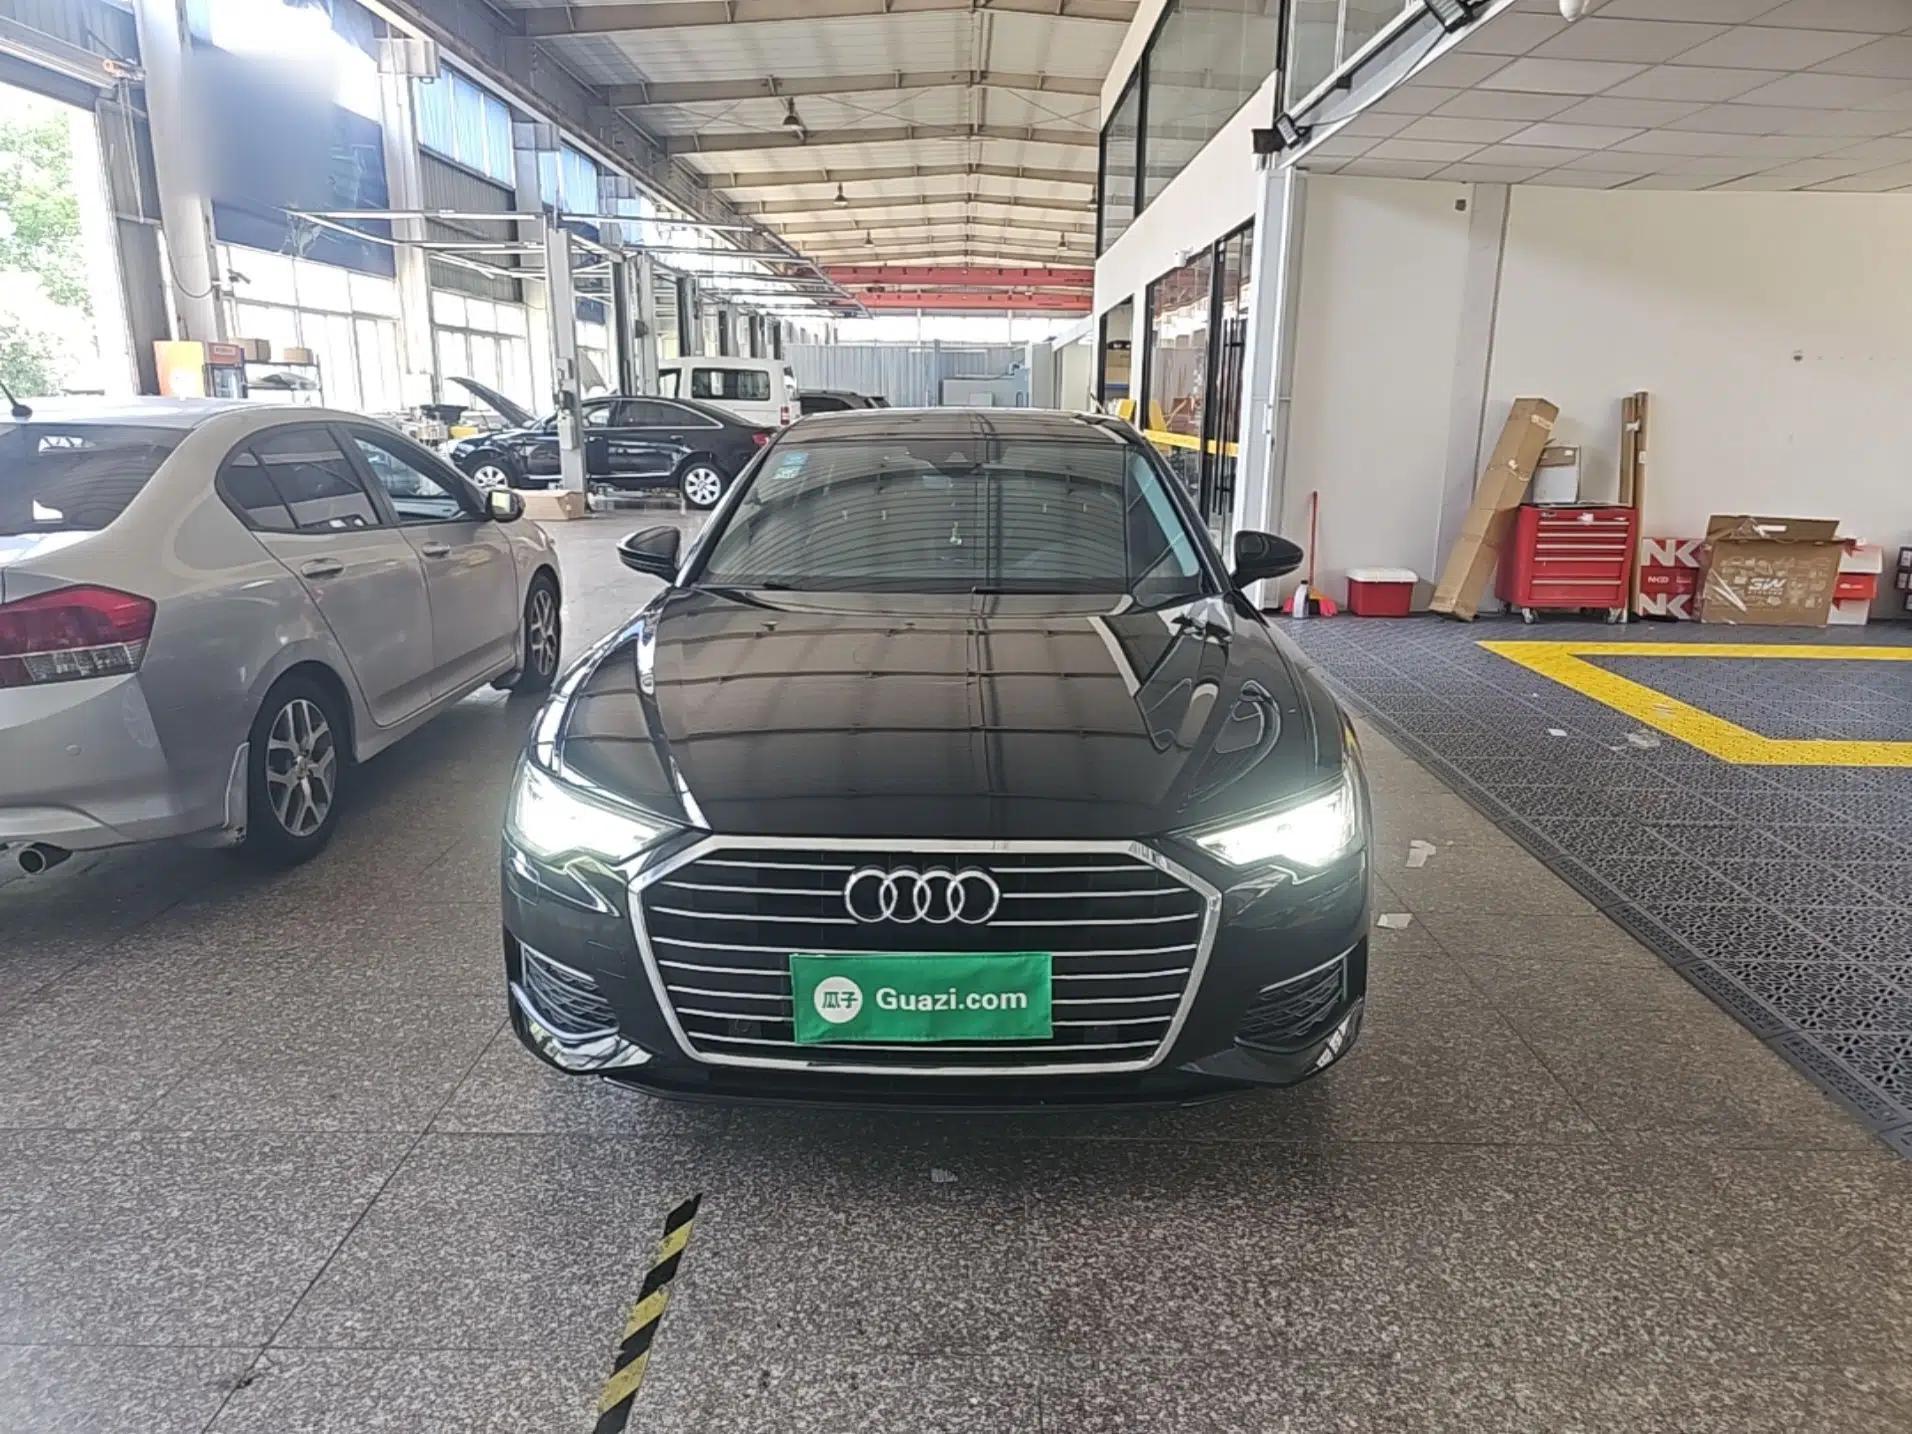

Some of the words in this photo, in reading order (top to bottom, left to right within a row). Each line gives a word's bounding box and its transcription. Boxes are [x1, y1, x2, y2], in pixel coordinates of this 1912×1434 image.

[1640, 539, 1702, 567] NK
[1639, 593, 1692, 619] NK
[822, 991, 858, 1009] 瓜子
[876, 987, 1028, 1011] Guazi.com
